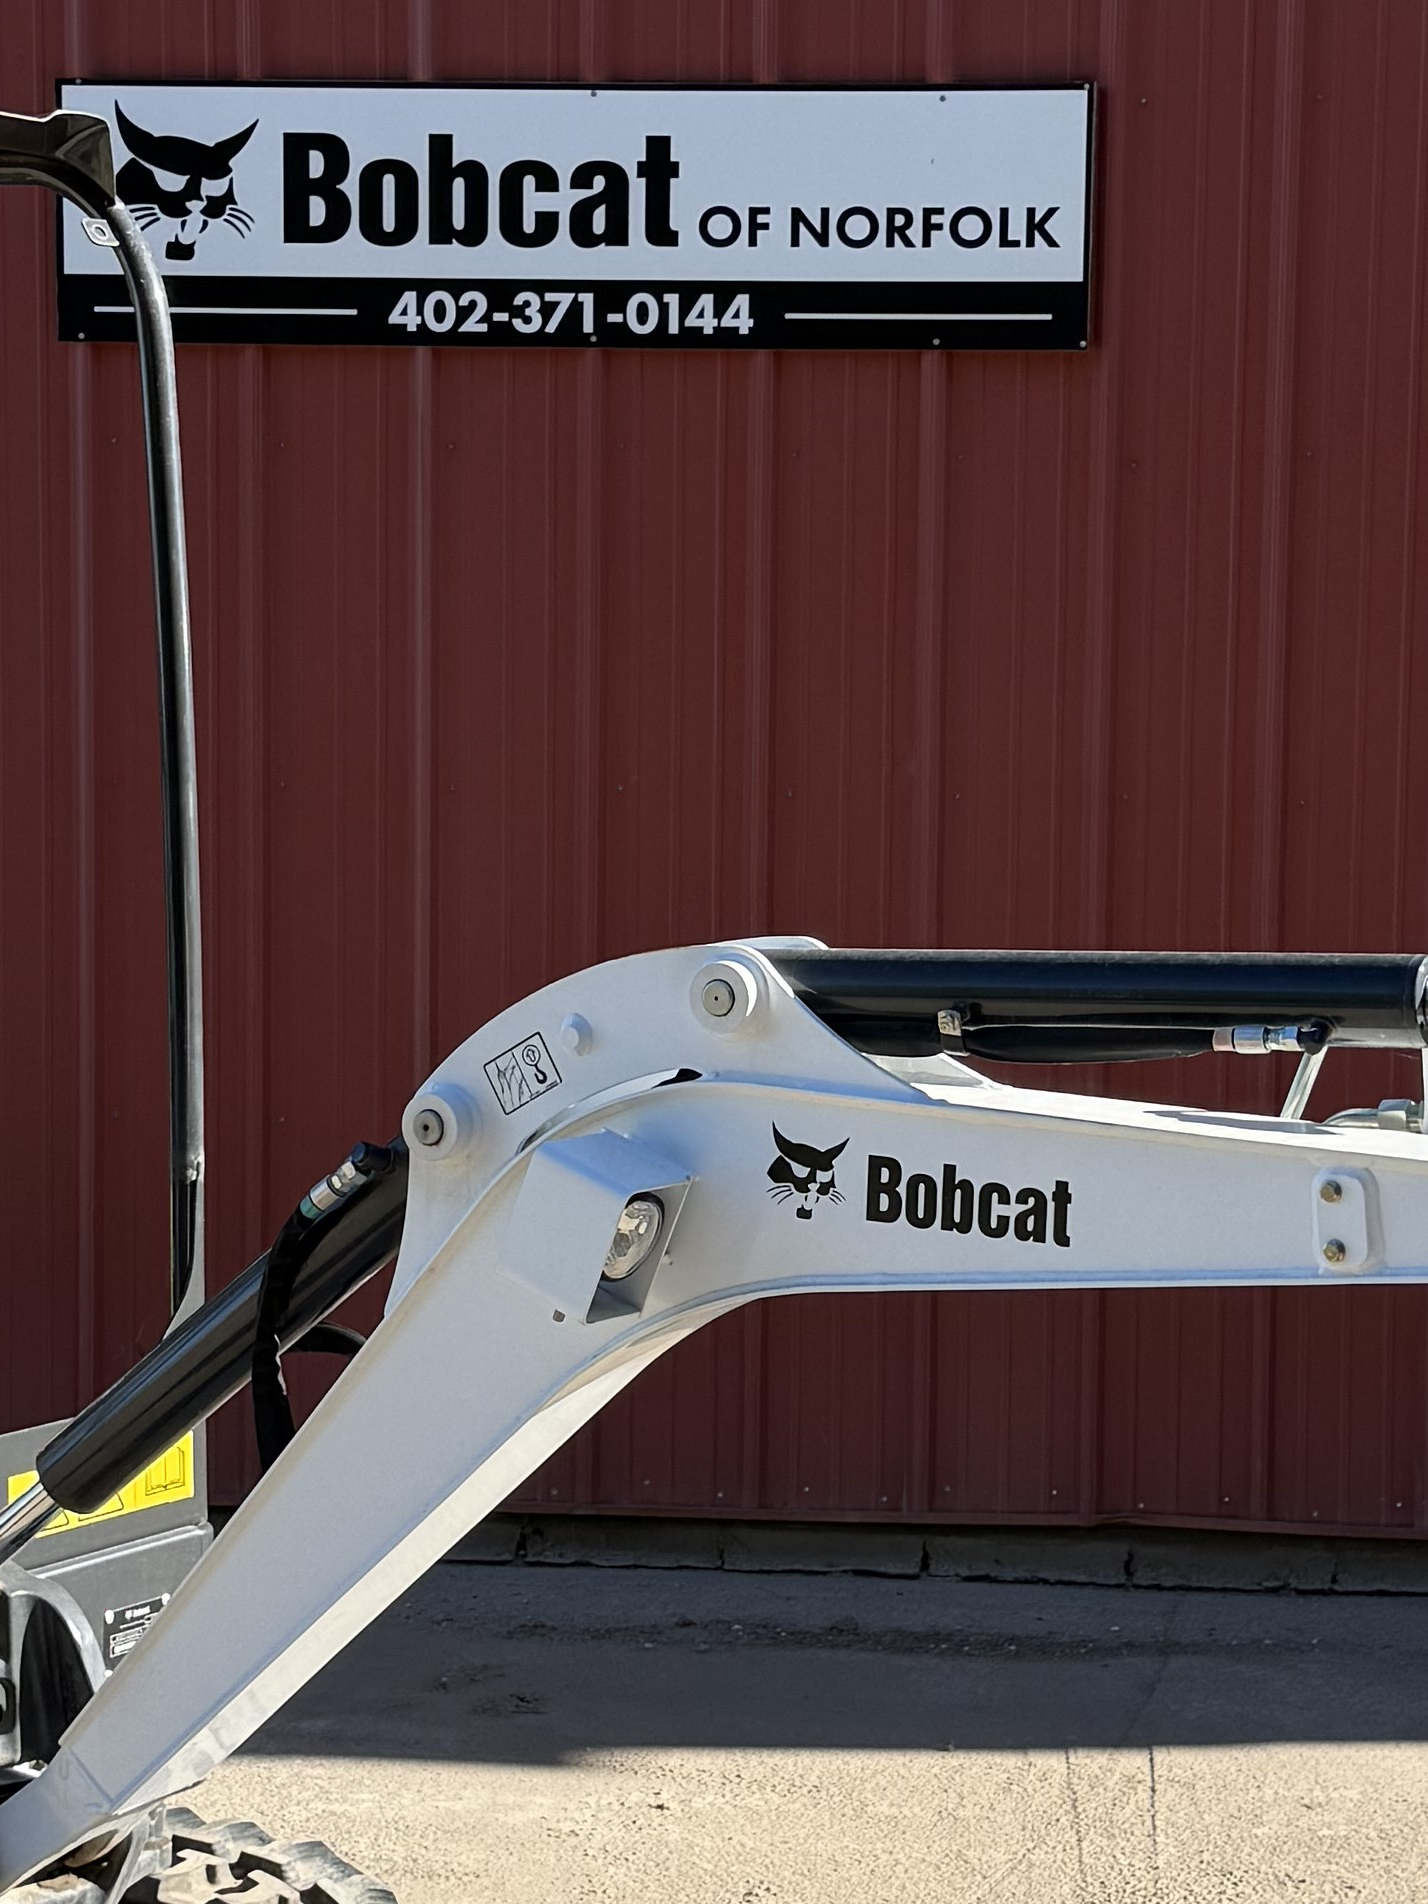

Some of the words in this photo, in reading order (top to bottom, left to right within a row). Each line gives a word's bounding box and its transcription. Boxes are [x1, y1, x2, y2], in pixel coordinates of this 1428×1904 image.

[282, 131, 680, 249] Bobcat
[698, 206, 771, 251] OF
[791, 206, 1061, 252] NORFOLK
[387, 291, 754, 336] 402-371-0144
[865, 1154, 1073, 1248] Bobcat
